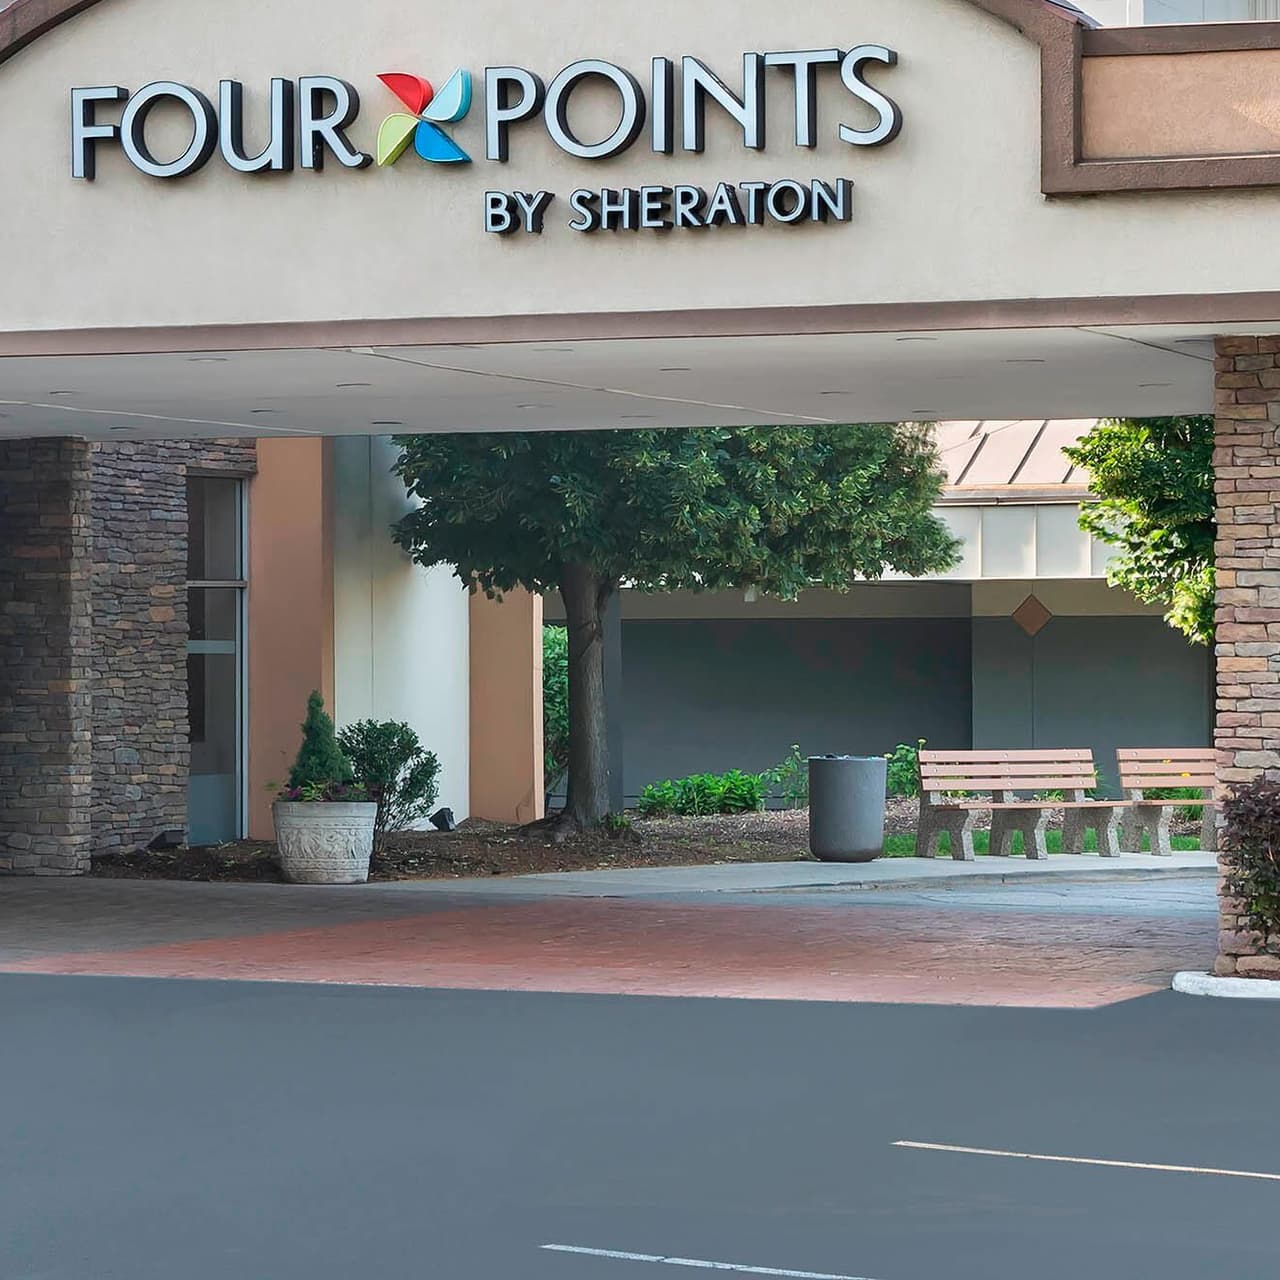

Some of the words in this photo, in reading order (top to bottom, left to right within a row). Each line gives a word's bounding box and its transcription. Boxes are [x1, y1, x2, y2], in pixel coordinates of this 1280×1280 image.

[70, 75, 374, 181] FOUR
[484, 43, 903, 162] POINTS
[484, 190, 555, 234] BY
[568, 177, 855, 232] SHERATON
